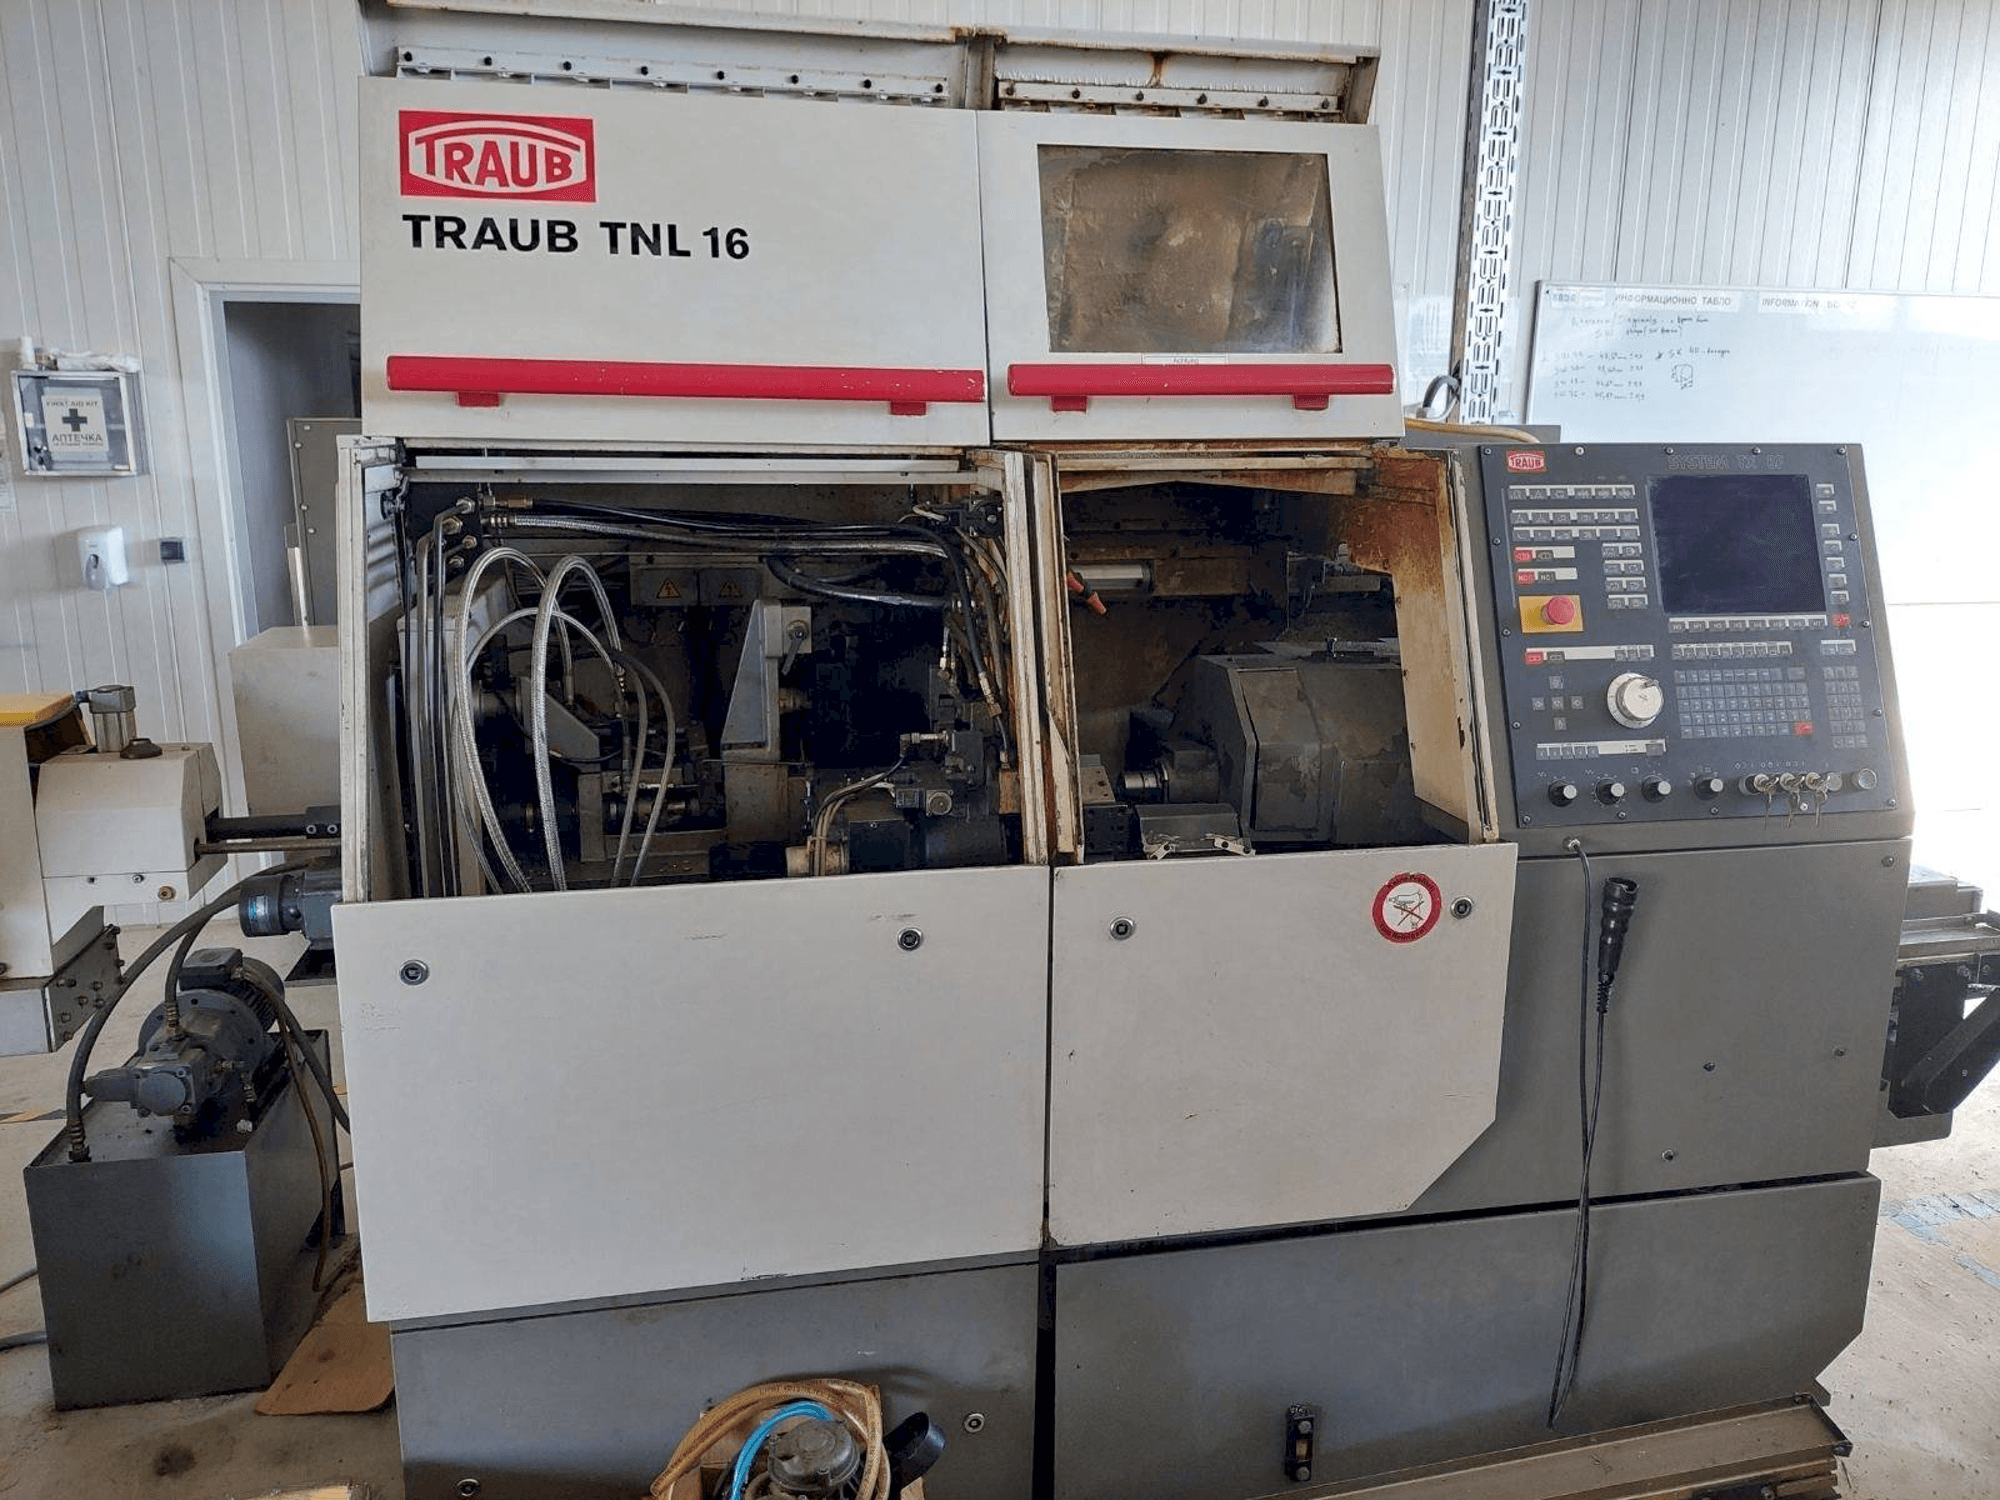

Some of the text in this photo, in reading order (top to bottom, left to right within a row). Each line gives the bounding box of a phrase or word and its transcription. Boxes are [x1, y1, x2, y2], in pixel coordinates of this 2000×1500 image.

[413, 125, 582, 188] TRAUB
[402, 213, 750, 260] TRAUB TNL 16
[1761, 298, 1819, 309] INFORMAION
[52, 433, 102, 441] АПТЕЧКА
[1509, 454, 1544, 468] TRAUB
[1668, 453, 1730, 470] SYSTEM
